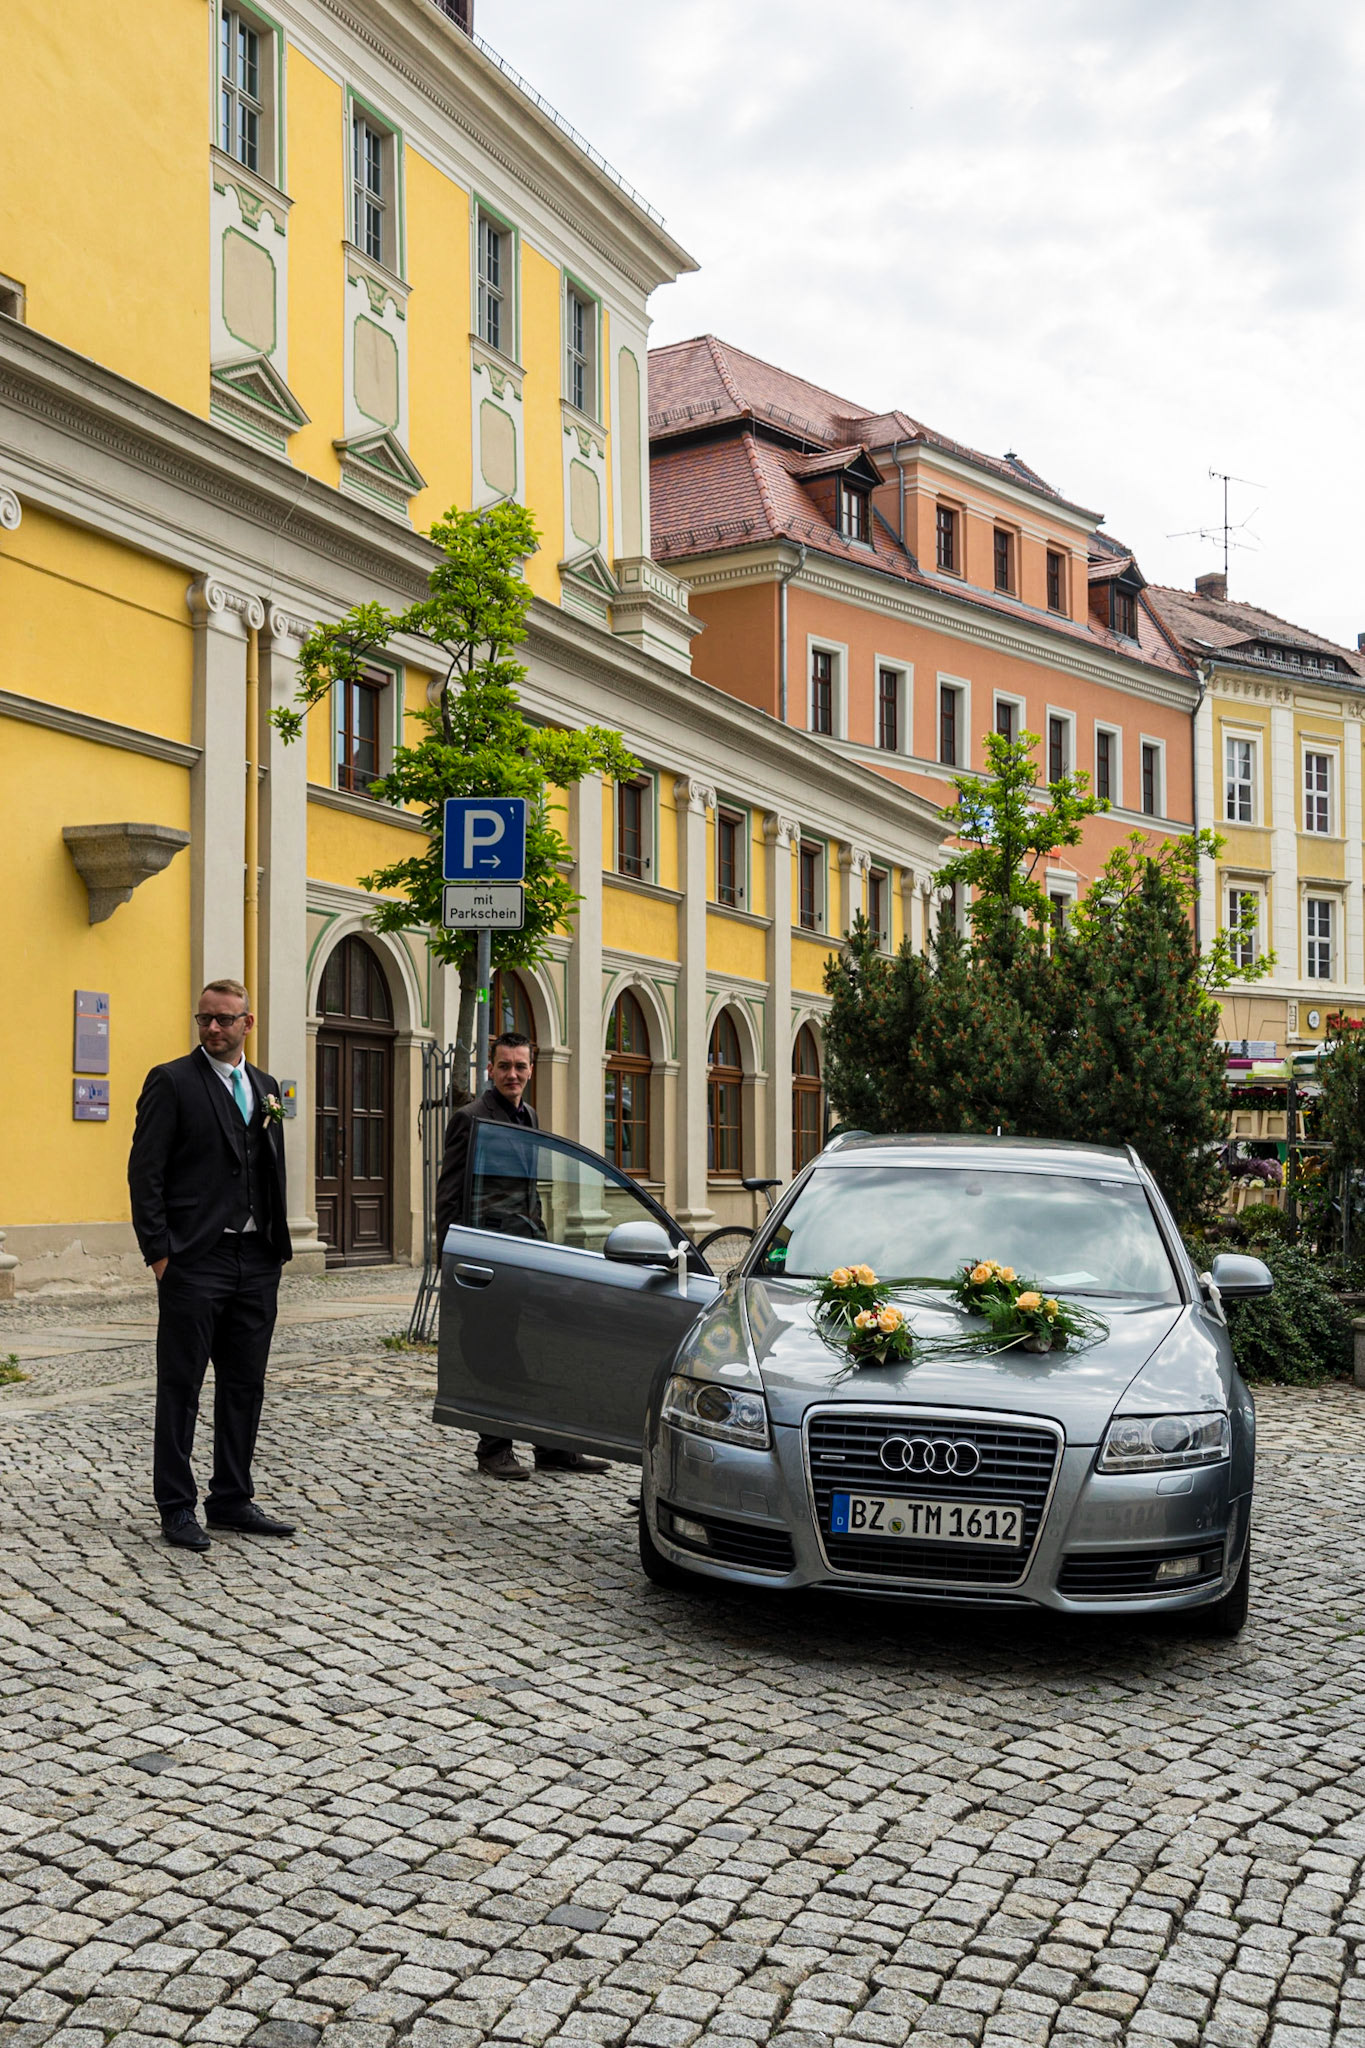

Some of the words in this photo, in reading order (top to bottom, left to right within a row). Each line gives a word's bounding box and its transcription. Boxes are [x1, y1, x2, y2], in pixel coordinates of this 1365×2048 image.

[463, 809, 506, 869] P
[473, 894, 493, 905] mit
[450, 908, 517, 919] Parkschein
[836, 1516, 844, 1526] D
[851, 1499, 885, 1531] BZ
[908, 1503, 942, 1535] TM
[949, 1507, 1017, 1541] 1612
